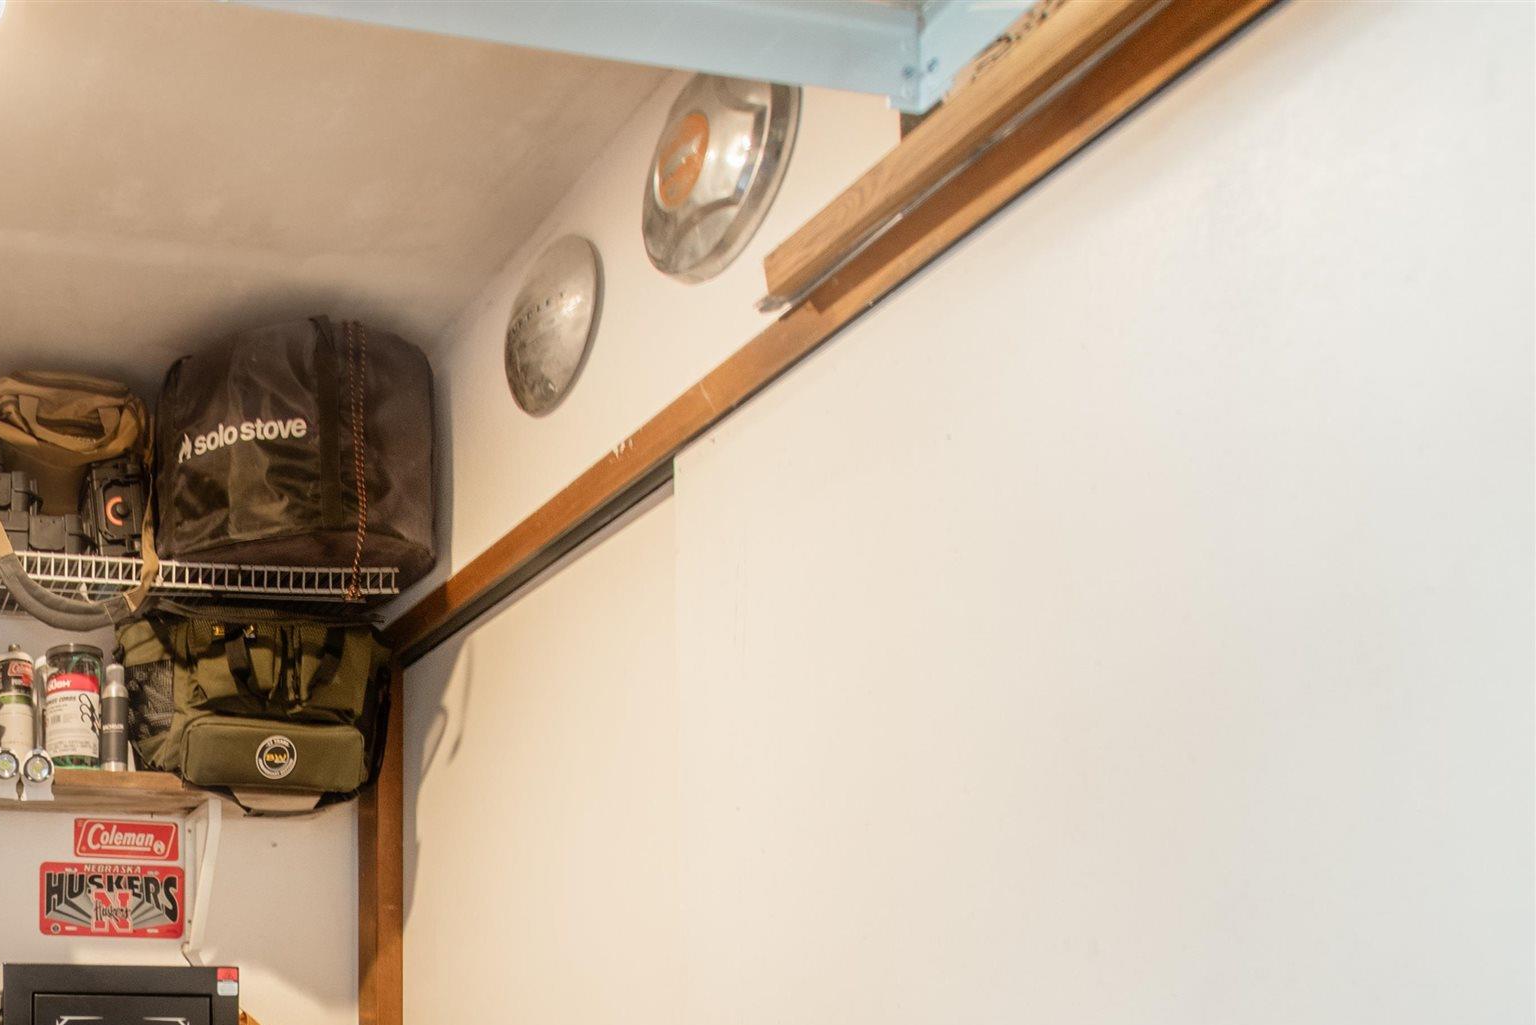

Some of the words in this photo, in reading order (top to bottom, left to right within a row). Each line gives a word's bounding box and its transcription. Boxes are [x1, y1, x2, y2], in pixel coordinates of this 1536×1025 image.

[194, 423, 239, 456] solo
[240, 418, 307, 442] stove
[87, 823, 154, 850] Coleman
[83, 864, 142, 875] NEBRASKA
[45, 872, 179, 923] HUSKERS
